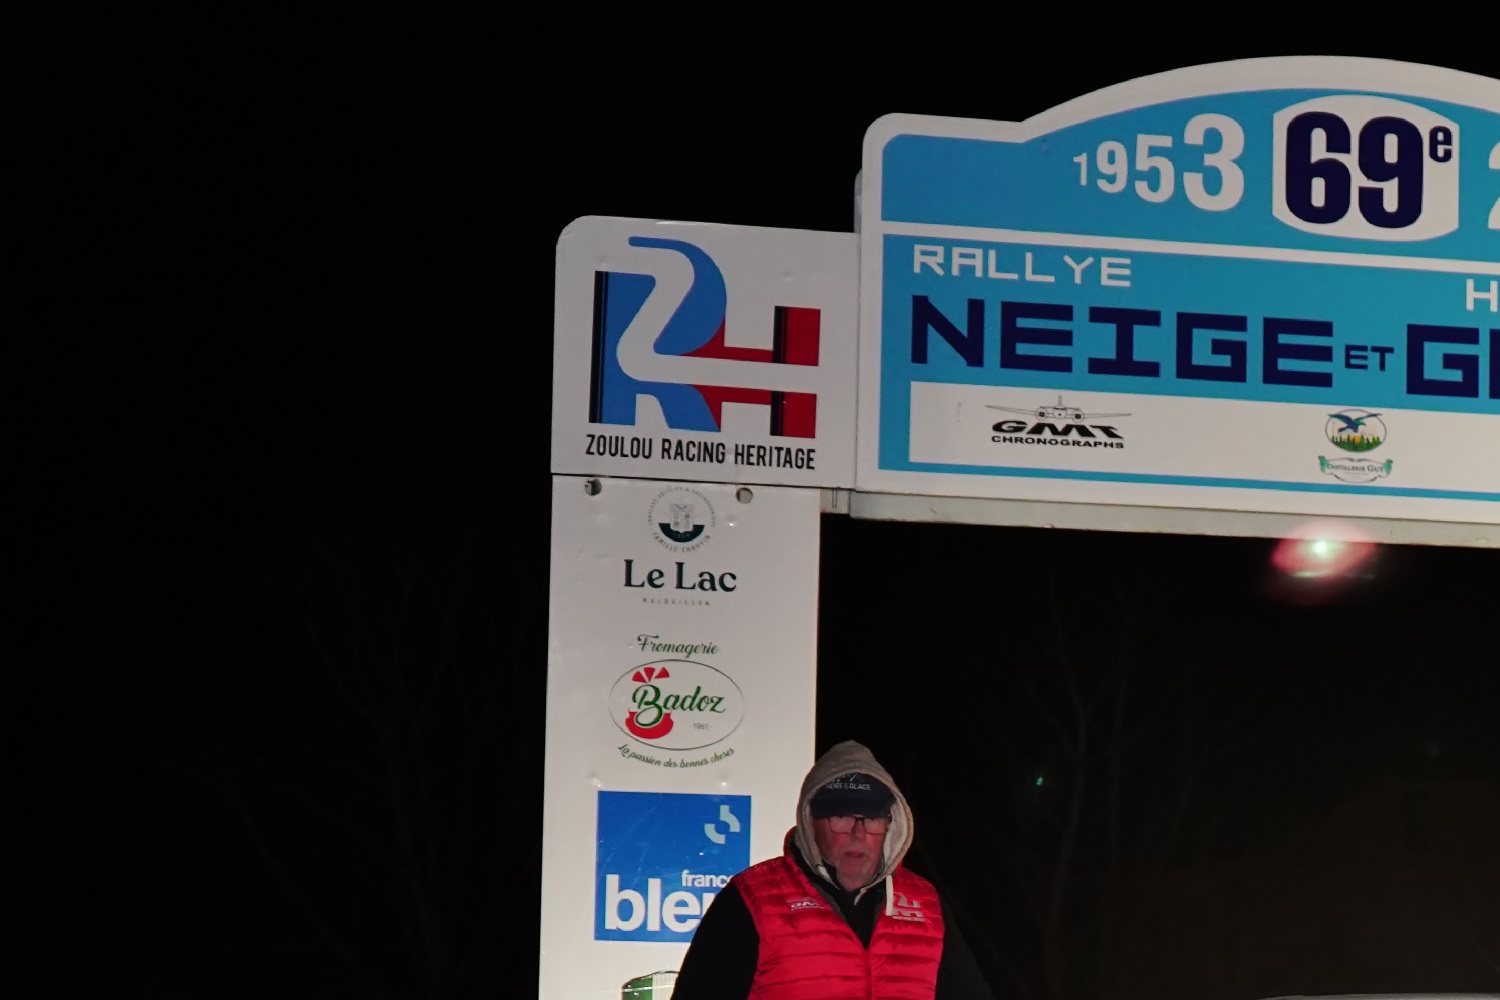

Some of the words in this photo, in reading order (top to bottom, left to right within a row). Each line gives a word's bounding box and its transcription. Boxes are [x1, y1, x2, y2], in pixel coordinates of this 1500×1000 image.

[1073, 113, 1245, 212] 1953
[913, 244, 1131, 287] RALLYE
[911, 295, 1333, 388] NEIGE
[1344, 344, 1394, 371] ET
[991, 435, 1125, 449] CHRONOGRAPHS
[992, 420, 1124, 439] GMT
[586, 434, 652, 458] ZOULOU
[661, 438, 726, 464] RACING
[734, 443, 816, 470] HERITAGE
[624, 559, 664, 589] Le
[675, 561, 737, 592] Lac
[636, 634, 719, 658] Fromagerie
[632, 684, 726, 727] Badoz
[628, 752, 661, 766] passion
[663, 759, 678, 768] des
[679, 757, 709, 768] bonnes
[710, 747, 735, 763] choses
